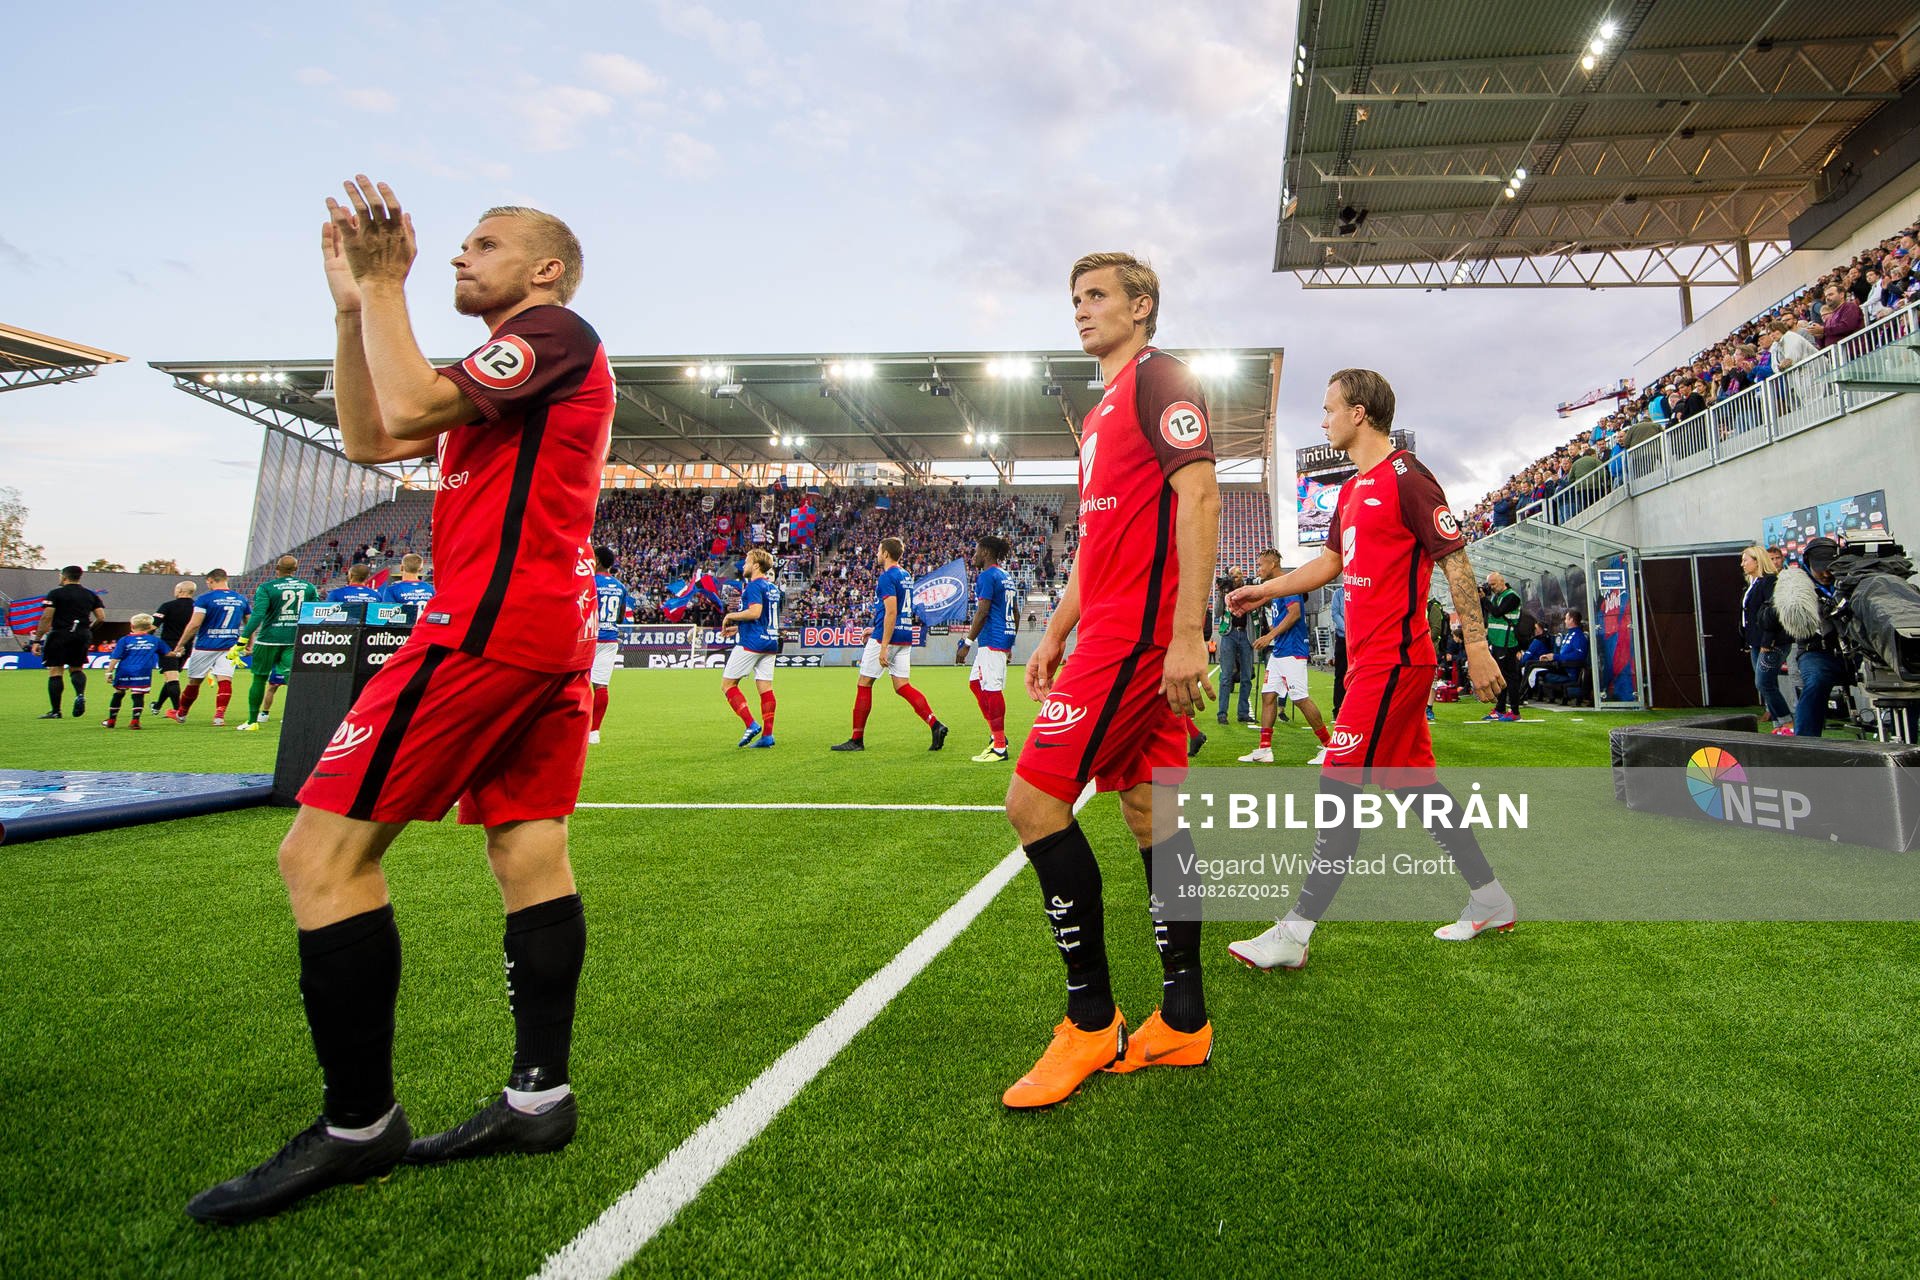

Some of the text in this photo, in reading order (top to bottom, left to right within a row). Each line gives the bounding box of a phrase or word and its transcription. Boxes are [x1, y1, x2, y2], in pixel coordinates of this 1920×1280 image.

[480, 344, 520, 376] 12
[1170, 414, 1199, 436] 12
[1302, 446, 1345, 463] intility
[1392, 458, 1408, 475] BOB
[438, 471, 469, 491] ken
[1440, 514, 1456, 530] 12
[282, 589, 305, 614] 21
[600, 595, 620, 622] 19
[901, 589, 912, 617] 4
[223, 606, 235, 629] 7
[301, 630, 353, 645] altibox
[366, 632, 409, 646] altibox
[302, 652, 346, 667] coop
[367, 652, 393, 665] coo
[1040, 699, 1082, 722] RØY
[331, 720, 366, 746] ØY
[1331, 730, 1359, 747] RØY
[1722, 783, 1811, 831] NEP
